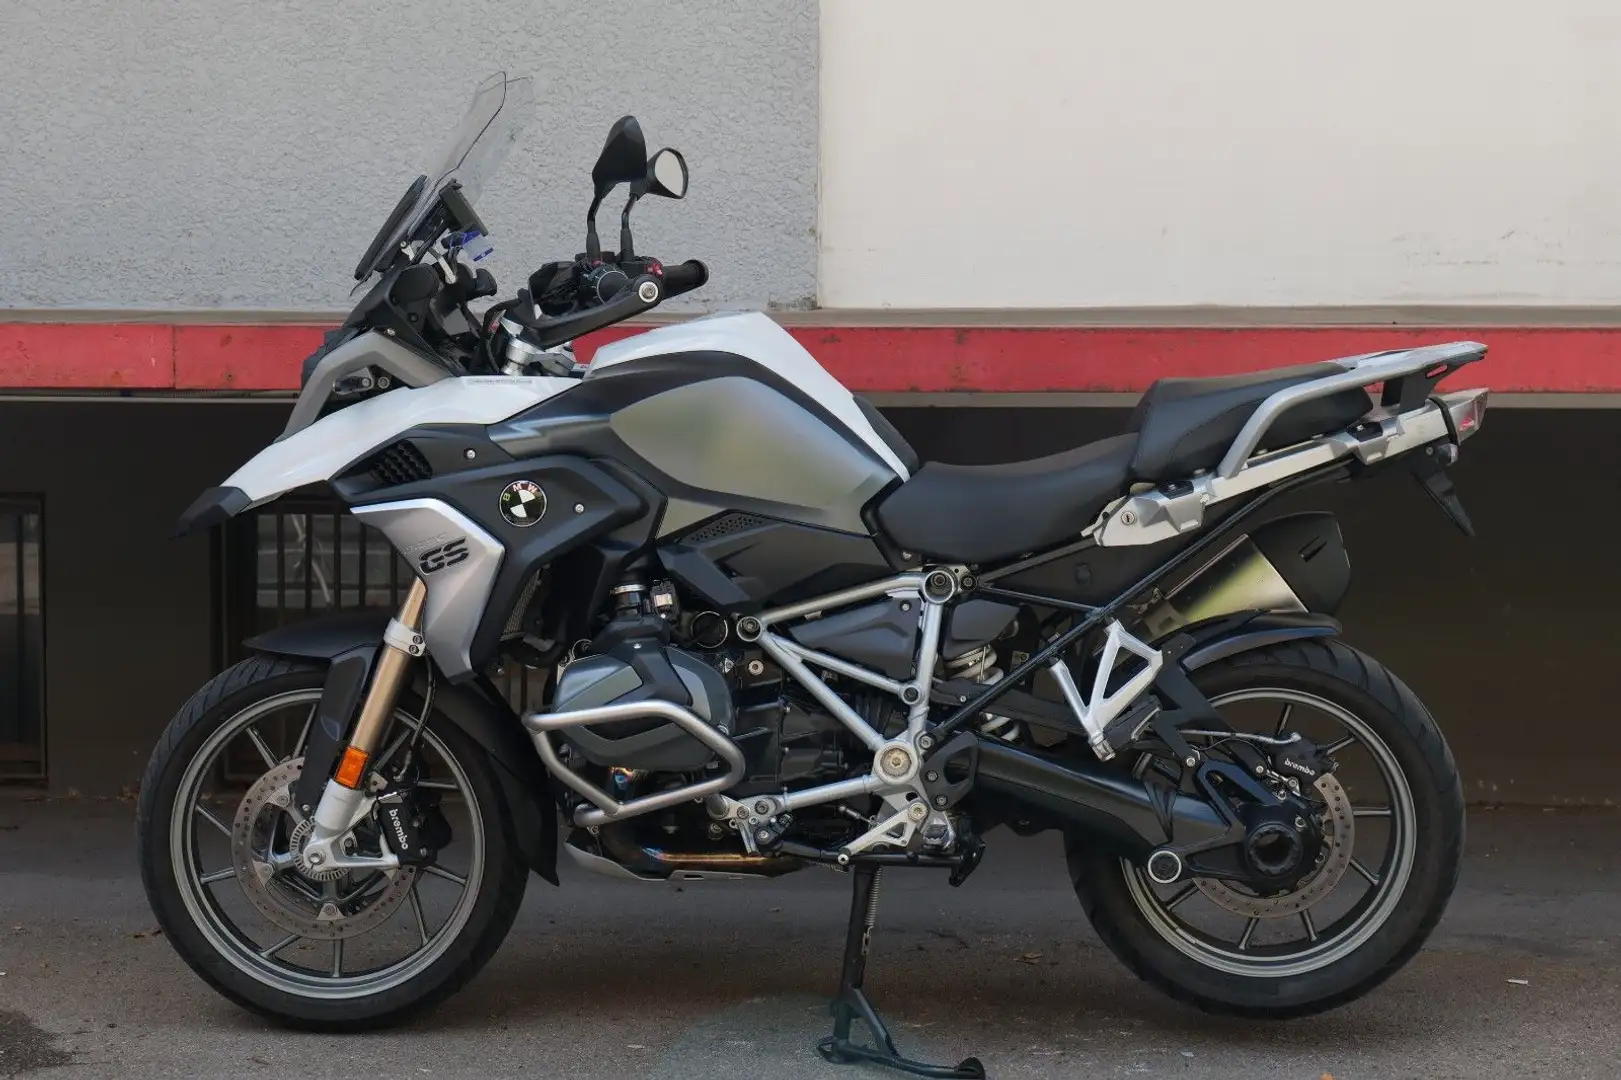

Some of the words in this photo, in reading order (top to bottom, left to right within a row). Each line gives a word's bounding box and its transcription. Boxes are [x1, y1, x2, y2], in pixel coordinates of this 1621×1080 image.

[502, 482, 538, 502] BMW
[418, 537, 469, 574] GS
[1284, 757, 1316, 776] brembo
[388, 808, 409, 850] brembo
